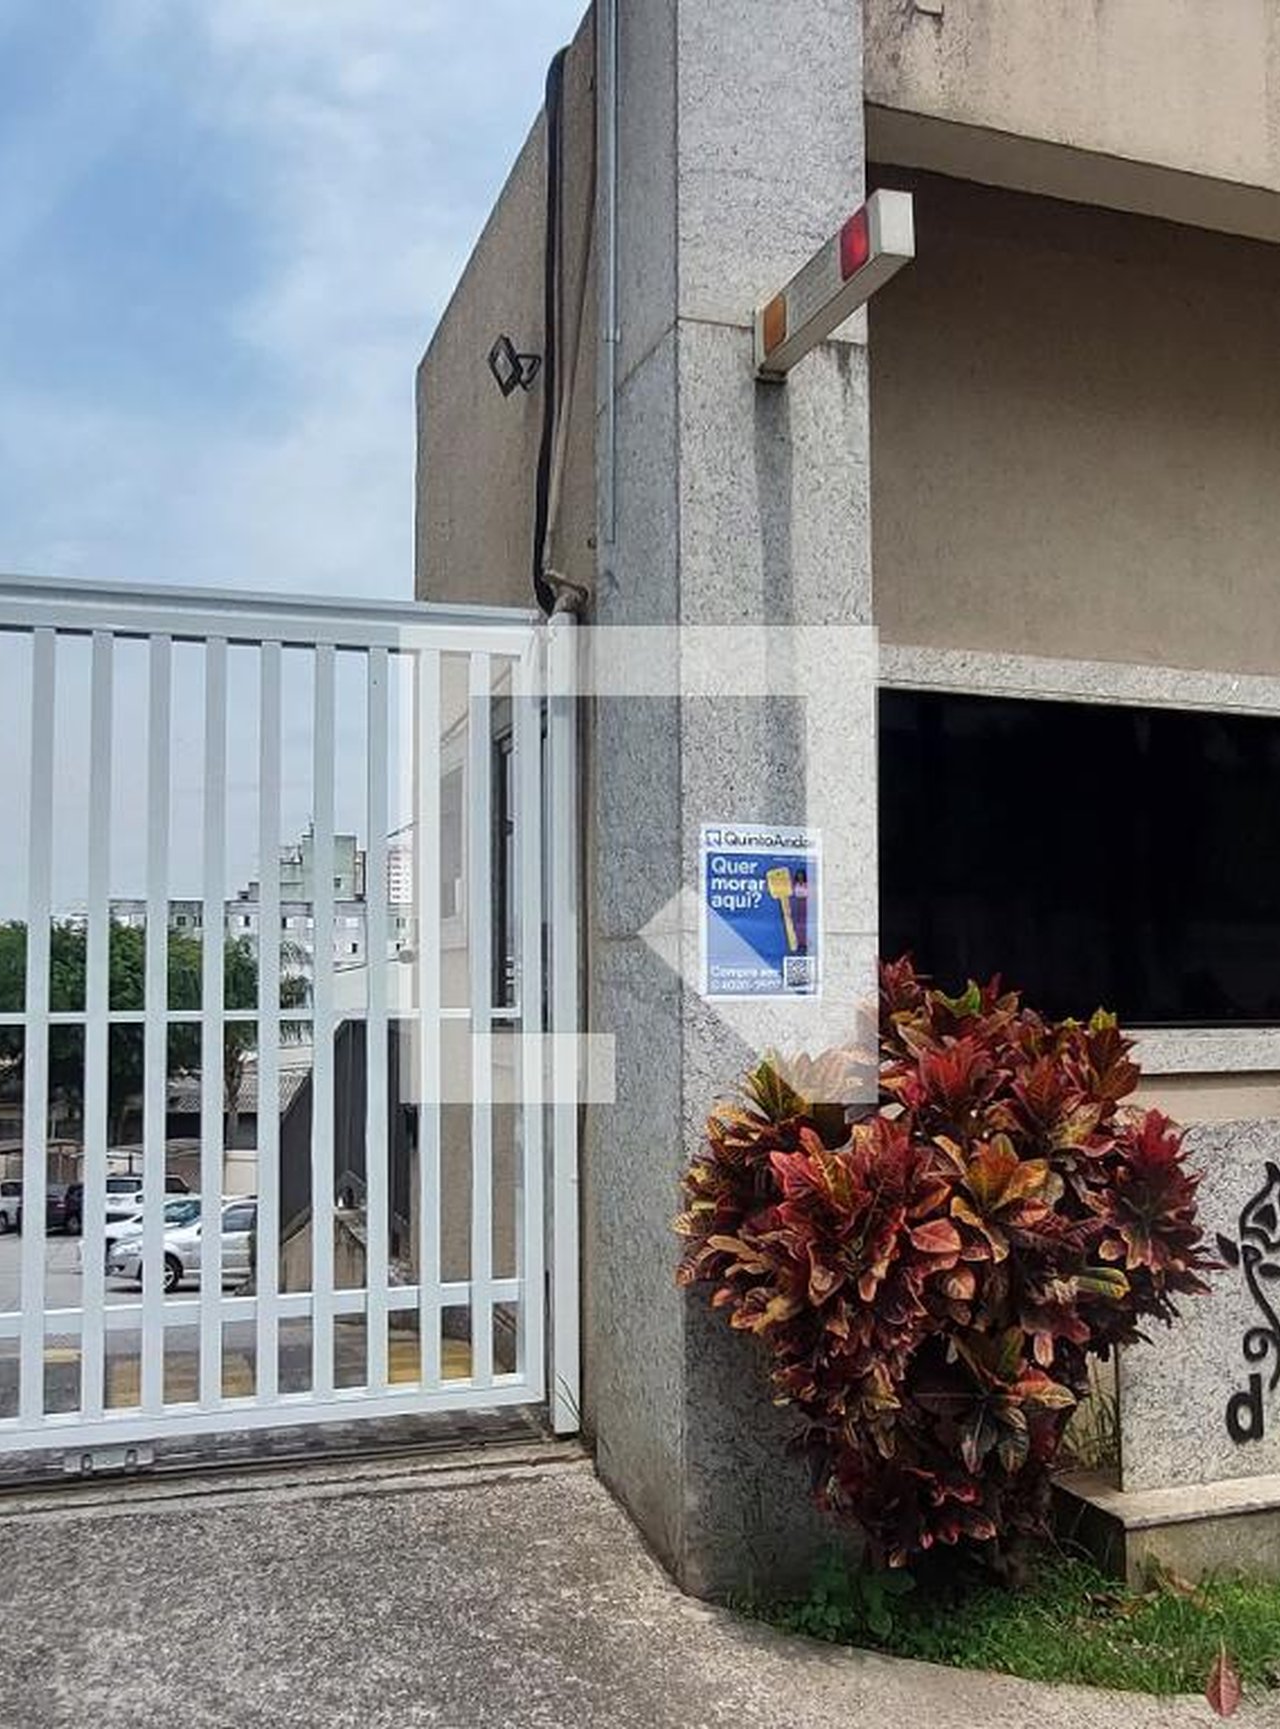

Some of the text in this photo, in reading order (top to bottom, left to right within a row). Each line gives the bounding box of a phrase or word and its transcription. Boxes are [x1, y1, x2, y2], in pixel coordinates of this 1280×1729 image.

[711, 856, 759, 875] Quer
[711, 877, 766, 891] morar
[711, 892, 762, 911] aqui?
